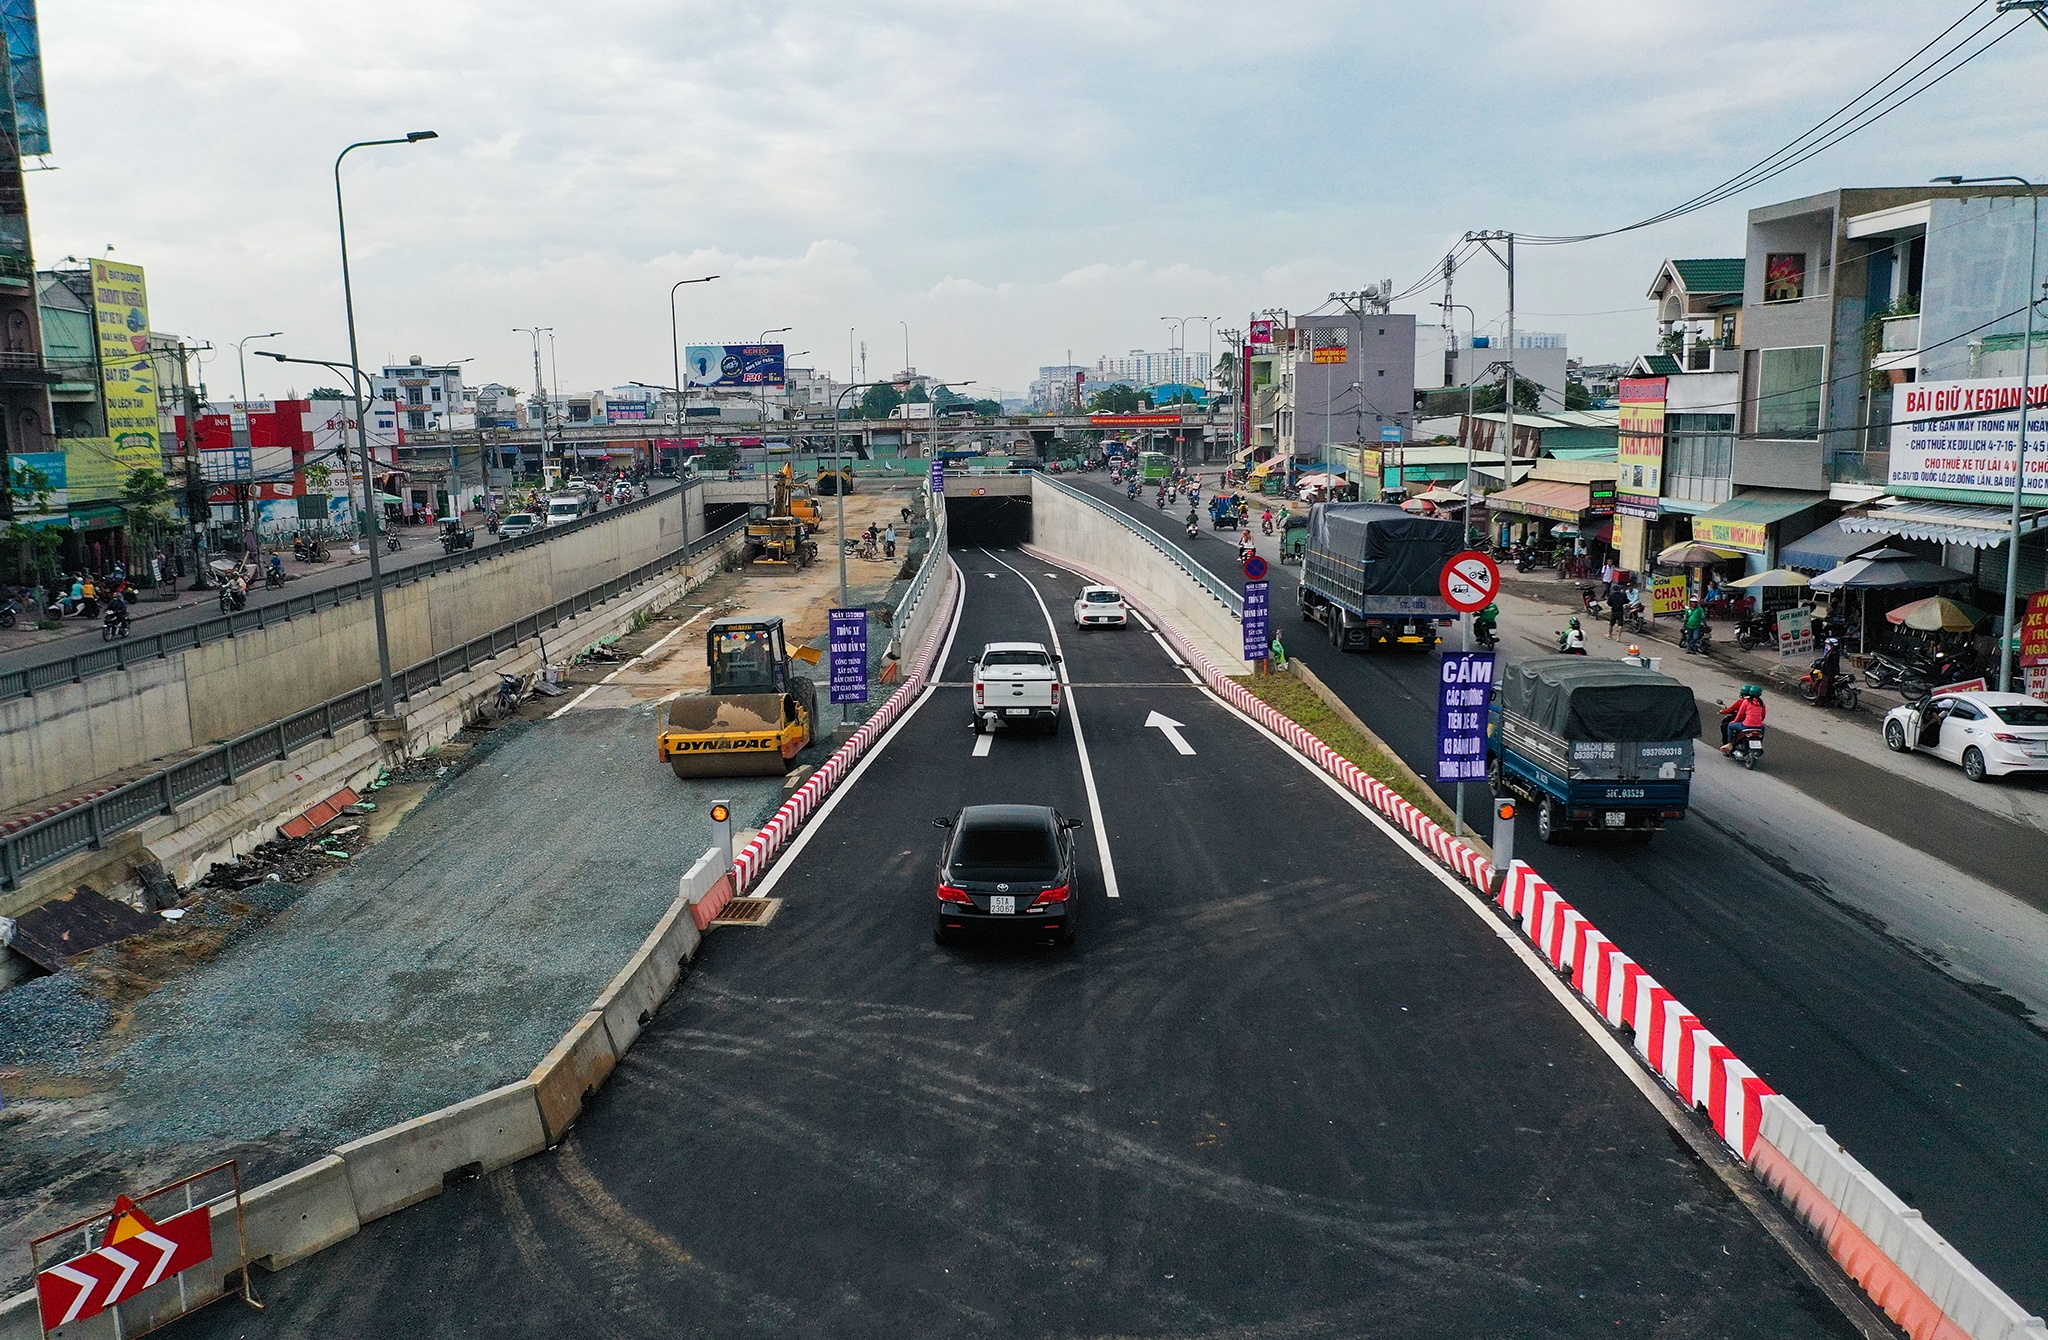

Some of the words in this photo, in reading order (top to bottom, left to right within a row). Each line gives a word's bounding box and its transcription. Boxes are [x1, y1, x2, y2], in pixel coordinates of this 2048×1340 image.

[743, 373, 763, 382] F20
[1906, 387, 1932, 412] BÃI
[1936, 385, 1961, 412] GIỮ
[1928, 420, 1937, 432] XE
[1977, 420, 2004, 432] TRONG
[1911, 440, 1926, 450] CHO
[1947, 440, 1957, 450] XE
[1958, 440, 1968, 450] DU
[1969, 440, 1986, 453] LỊCH
[1925, 458, 1940, 468] CHO
[1962, 459, 1972, 470] XE
[1988, 457, 2001, 471] LÁI
[2004, 461, 2009, 471] 4
[2025, 461, 2030, 472] 7
[1654, 586, 1684, 600] CHAY
[1666, 600, 1685, 610] 10K
[2026, 613, 2043, 626] XE
[853, 626, 860, 635] XE
[1442, 654, 1492, 683] CẤM
[1446, 686, 1459, 706] CÁC
[1460, 688, 1484, 706] PHƯƠNG
[1448, 710, 1462, 732] TIỆN
[1463, 713, 1469, 729] XE
[676, 739, 772, 750] DYNAPAC
[1444, 738, 1452, 754] 03
[1453, 735, 1468, 754] BÁNH
[1469, 736, 1480, 754] LƯU
[1439, 758, 1459, 777] THÔNG
[1460, 758, 1470, 777] VÀO
[1472, 755, 1485, 777] HẦM
